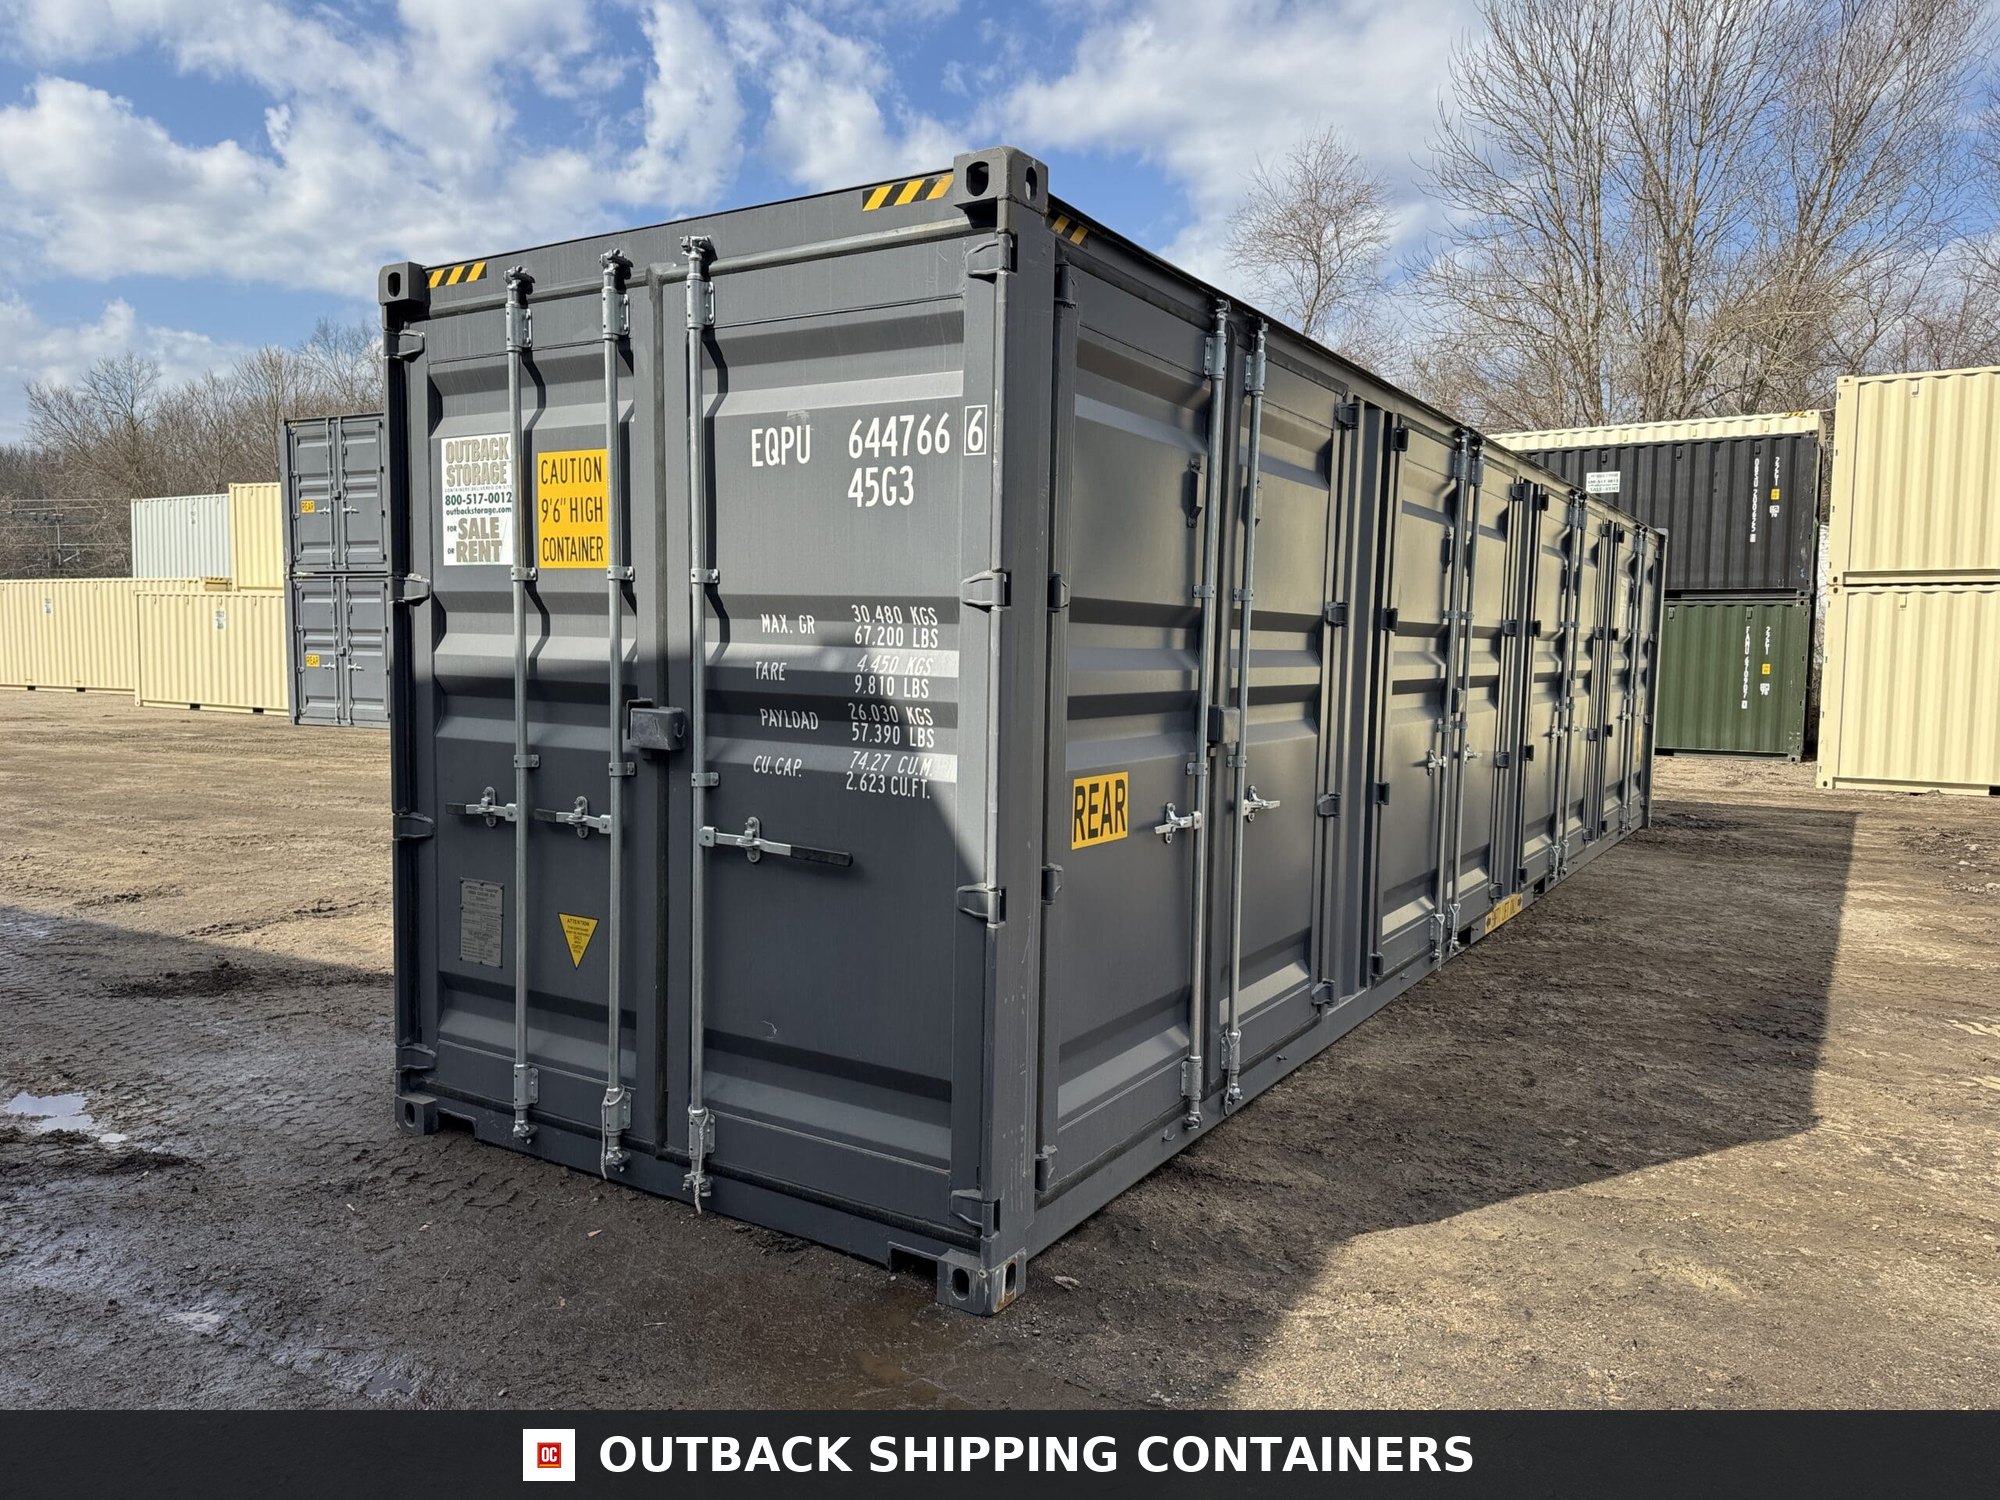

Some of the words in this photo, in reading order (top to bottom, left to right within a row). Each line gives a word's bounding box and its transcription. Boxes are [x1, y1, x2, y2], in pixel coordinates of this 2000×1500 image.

[751, 424, 811, 467] EQPU
[848, 412, 950, 459] 644766
[966, 408, 984, 452] 6
[446, 436, 510, 464] OUTBACK
[446, 461, 507, 487] STORAGE
[541, 456, 603, 485] CAUTION
[847, 465, 914, 508] 45G3
[445, 491, 512, 506] 800-517-0012
[570, 496, 603, 523] HIGH
[446, 506, 512, 516] outbackstorage.com
[458, 517, 499, 540] SALE
[456, 540, 502, 563] RENT
[542, 535, 604, 563] CONTAINER
[761, 614, 793, 634] MAX.
[799, 615, 815, 634] GR
[910, 606, 938, 626] KGS
[854, 626, 904, 646] 67,200
[912, 628, 938, 648] LBS
[755, 661, 787, 681] TARE
[905, 656, 934, 676] KGS
[854, 674, 895, 697] 9,810
[903, 677, 929, 699] LBS
[760, 708, 819, 731] PAYLOAD
[905, 706, 934, 727] KGS
[852, 722, 900, 745] 57,390
[909, 726, 934, 748] LBS
[753, 755, 802, 777] CU.CAP.
[850, 751, 891, 773] 74.27
[890, 775, 930, 800] CU.FT.
[1073, 778, 1126, 842] REAR
